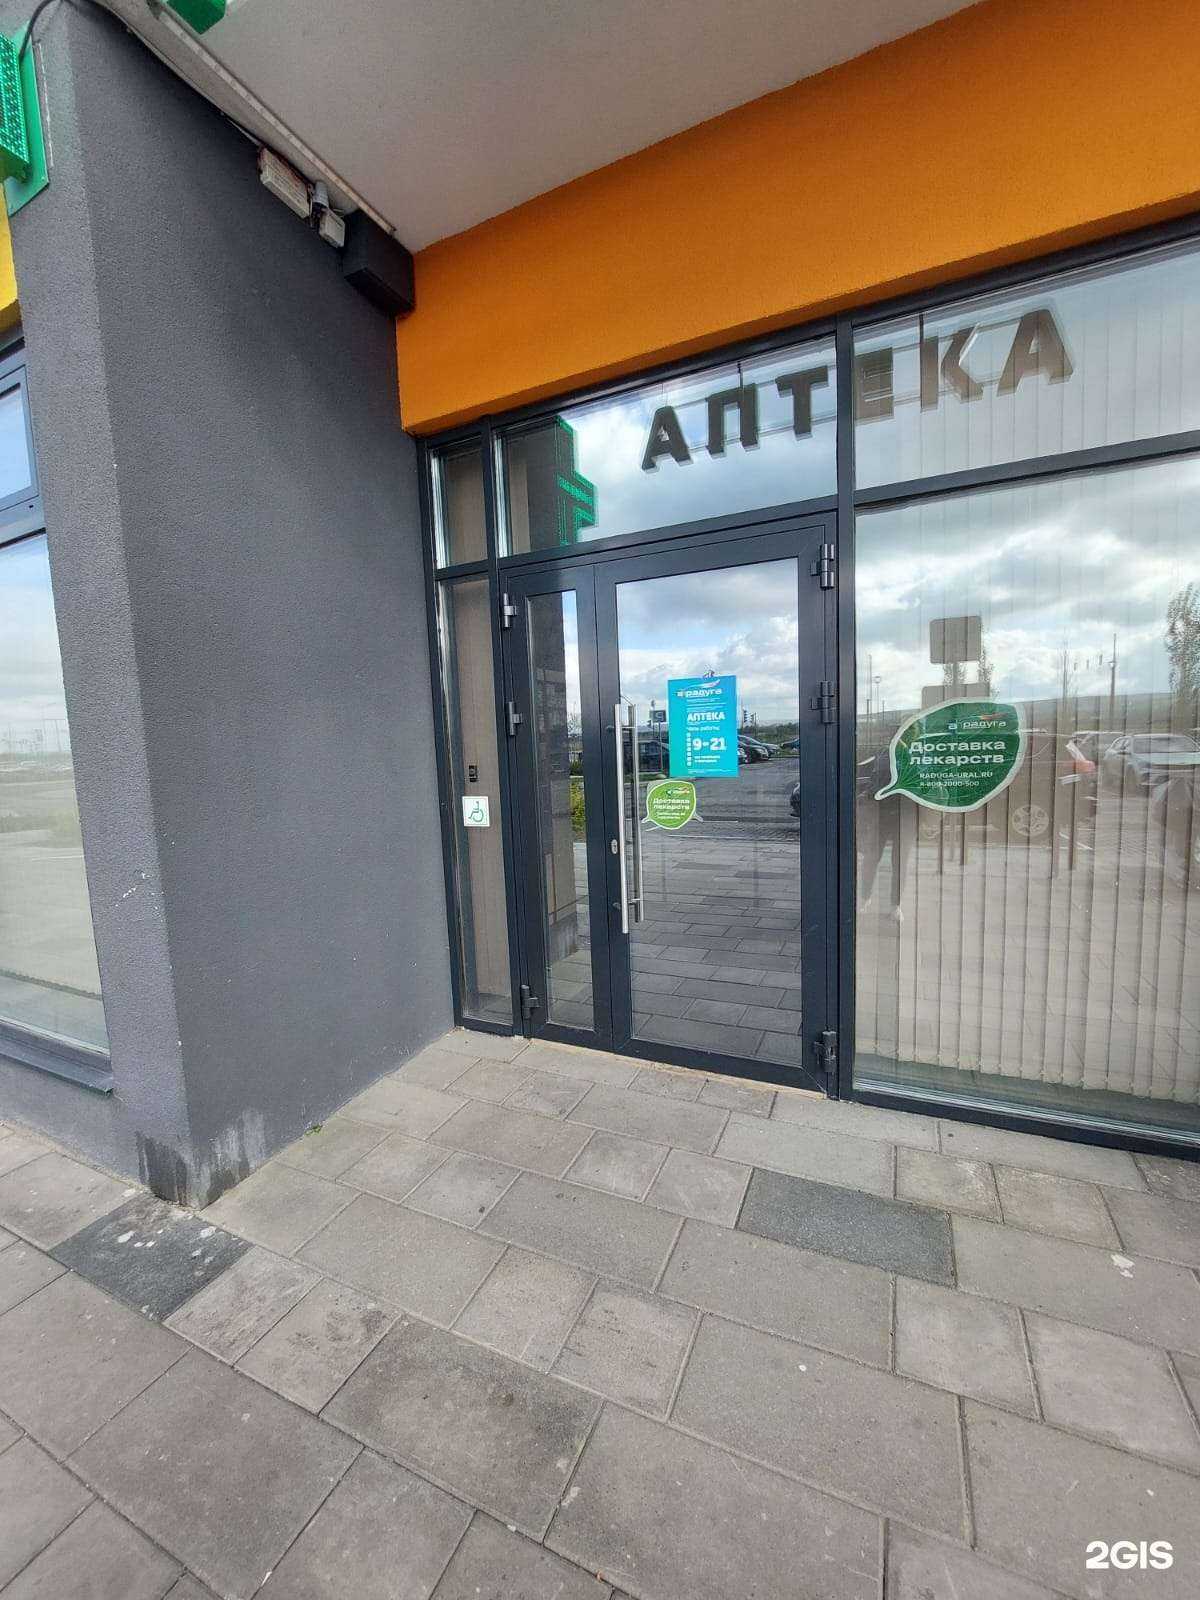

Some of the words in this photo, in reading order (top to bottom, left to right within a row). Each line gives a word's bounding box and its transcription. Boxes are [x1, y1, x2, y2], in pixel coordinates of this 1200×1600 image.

[641, 307, 1075, 474] АПТЕКА
[686, 688, 722, 698] радуга
[687, 711, 726, 722] АПТЕКА
[962, 719, 1007, 730] радуга
[692, 736, 728, 751] 9-21
[909, 741, 1006, 754] Доставка
[909, 754, 1005, 766] лекарств
[919, 771, 993, 780] RADUGA-URAL.RU
